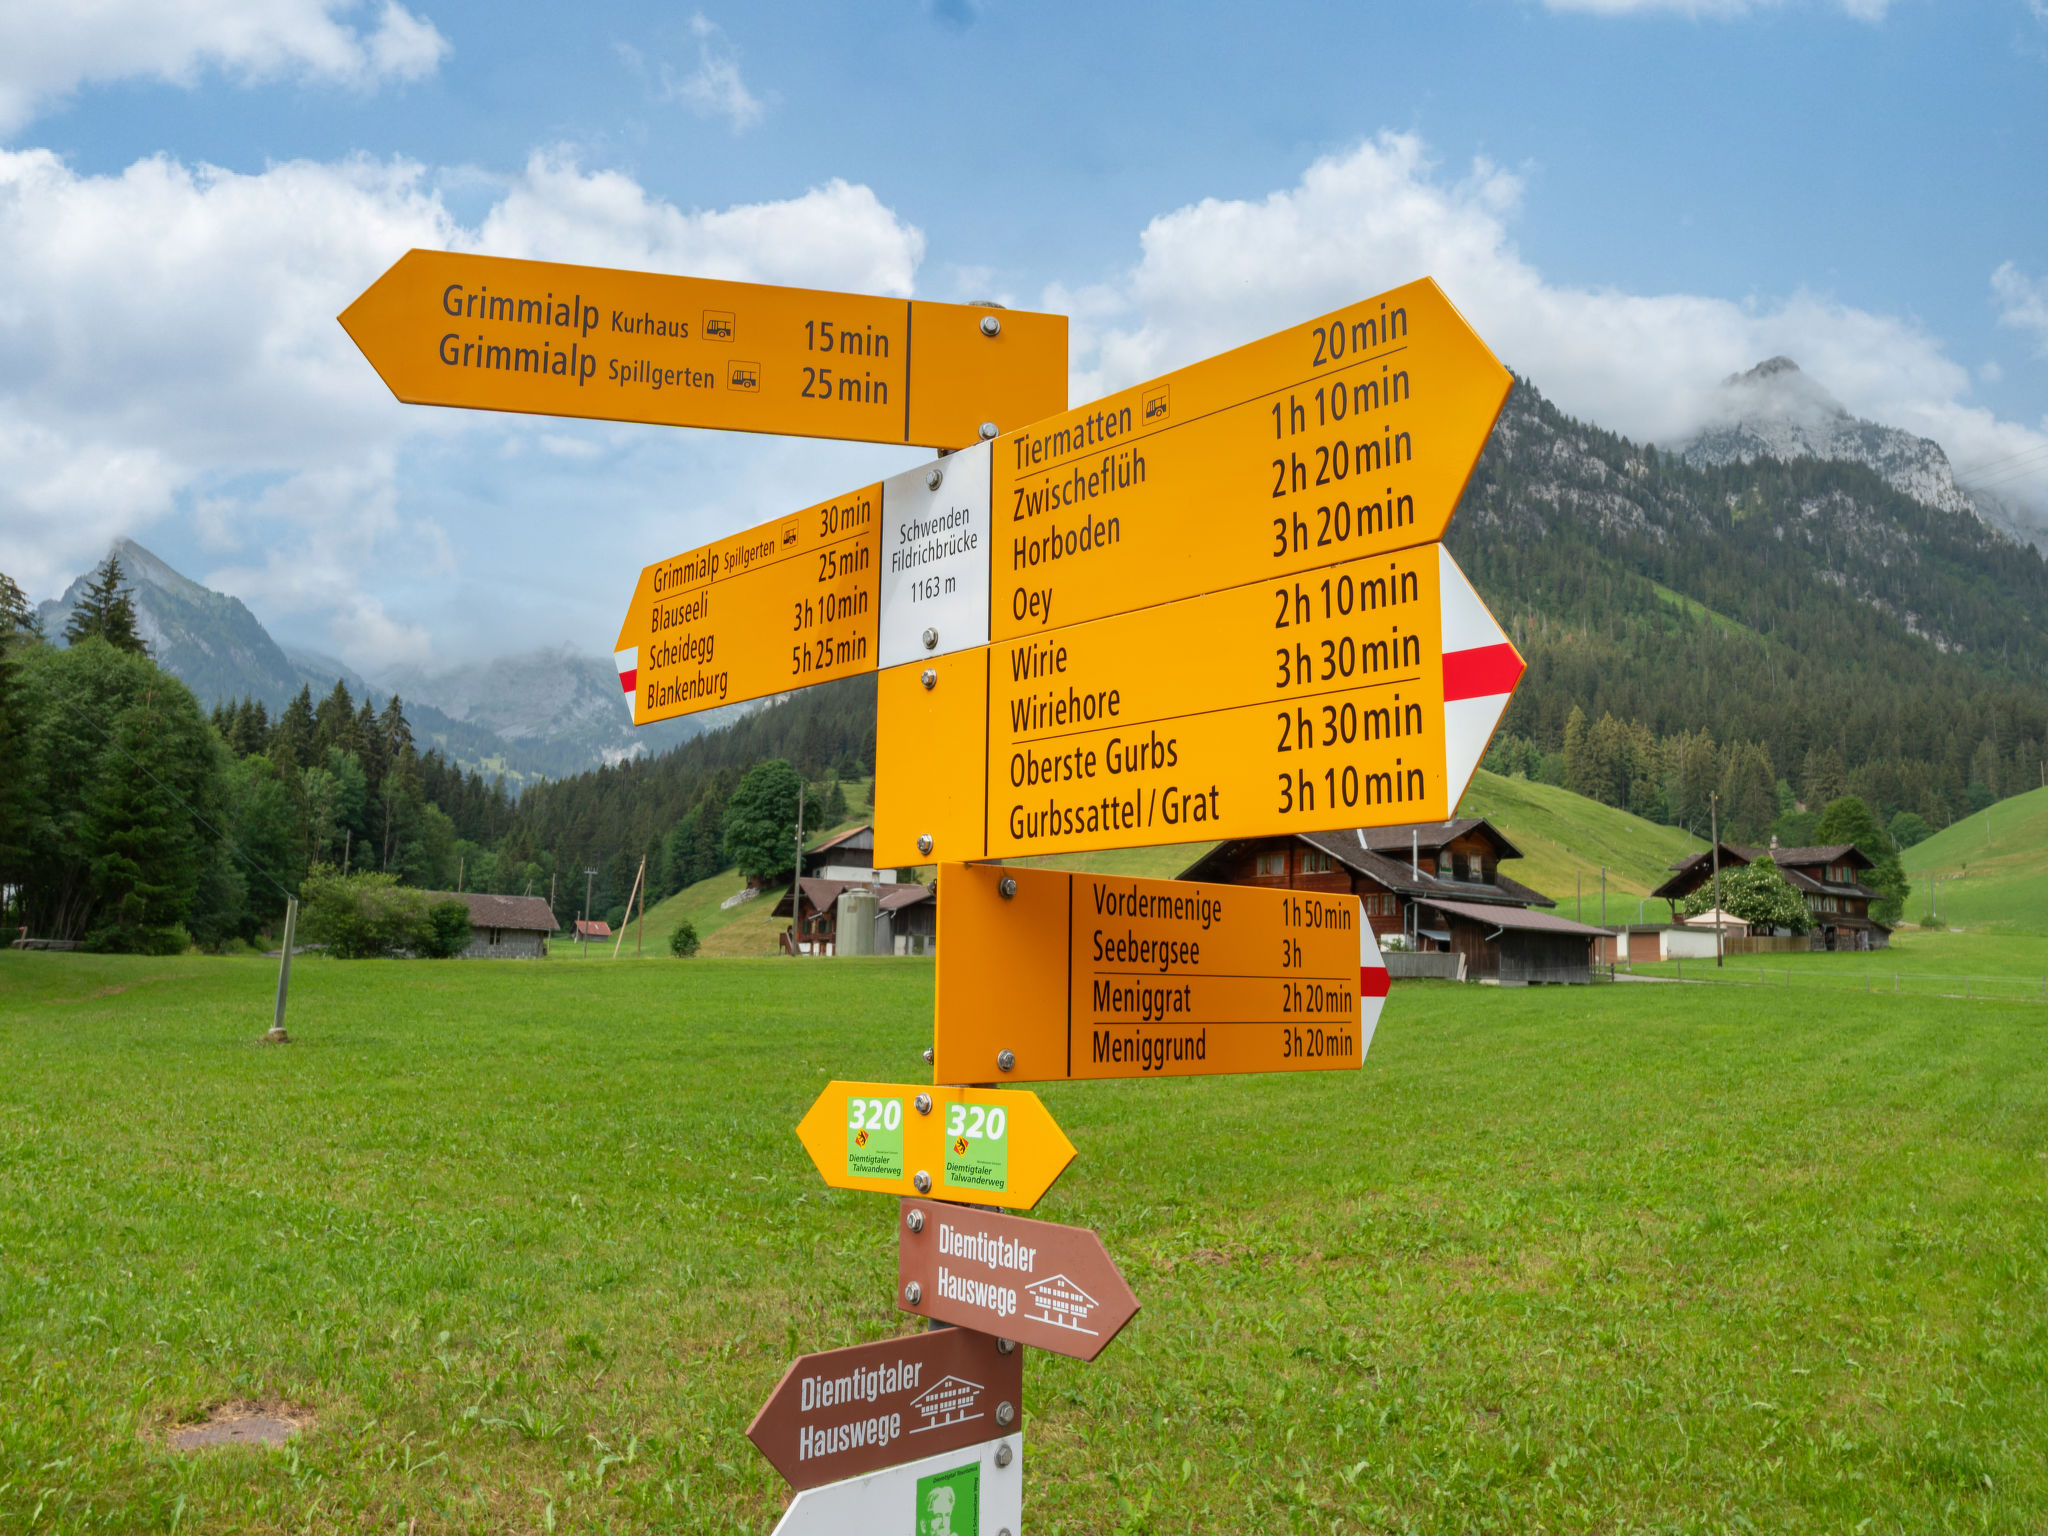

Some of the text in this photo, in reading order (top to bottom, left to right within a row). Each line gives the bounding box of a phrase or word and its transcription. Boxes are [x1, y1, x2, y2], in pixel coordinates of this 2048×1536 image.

[442, 283, 600, 338] Grimmialp
[611, 310, 689, 339] Kurhaus
[439, 333, 597, 387] Grimmialp
[608, 358, 715, 391] Spillgerten
[1013, 407, 1132, 470] Tiermatten
[1013, 447, 1146, 523] Zwischeflüh
[899, 506, 971, 545] Schwenden
[1013, 514, 1120, 571] Horboden
[653, 548, 720, 593] Grimmialp
[723, 540, 775, 574] Spillgerten
[891, 529, 978, 574] Fildrichbrücke
[651, 590, 709, 634] Blauseeli
[910, 575, 956, 604] 1163 m
[1012, 586, 1053, 625] Oey
[649, 632, 715, 672] Scheidegg
[1011, 640, 1068, 683] Wirie
[647, 669, 728, 710] Blankenburg
[1010, 685, 1121, 733] Wiriehore
[1010, 746, 1097, 788] Oberste
[1105, 729, 1178, 775] Gurbs
[1093, 882, 1222, 931] Vordermenige
[1093, 928, 1200, 973] Seebergsee
[1093, 979, 1192, 1022] Meniggrat
[1092, 1027, 1206, 1072] Meniggrund
[849, 1100, 901, 1131] 320
[947, 1105, 1006, 1140] 320
[849, 1154, 890, 1165] Diemtigtaler
[853, 1163, 901, 1176] Talwanderweg
[947, 1162, 992, 1175] Diemtigtaler
[951, 1173, 1004, 1189] Talwanderweg
[938, 1222, 1037, 1273] Diemtigtaler
[937, 1266, 1017, 1318] Hauswege
[800, 1359, 923, 1413] Diemtigtaler
[799, 1411, 901, 1462] Hauswege
